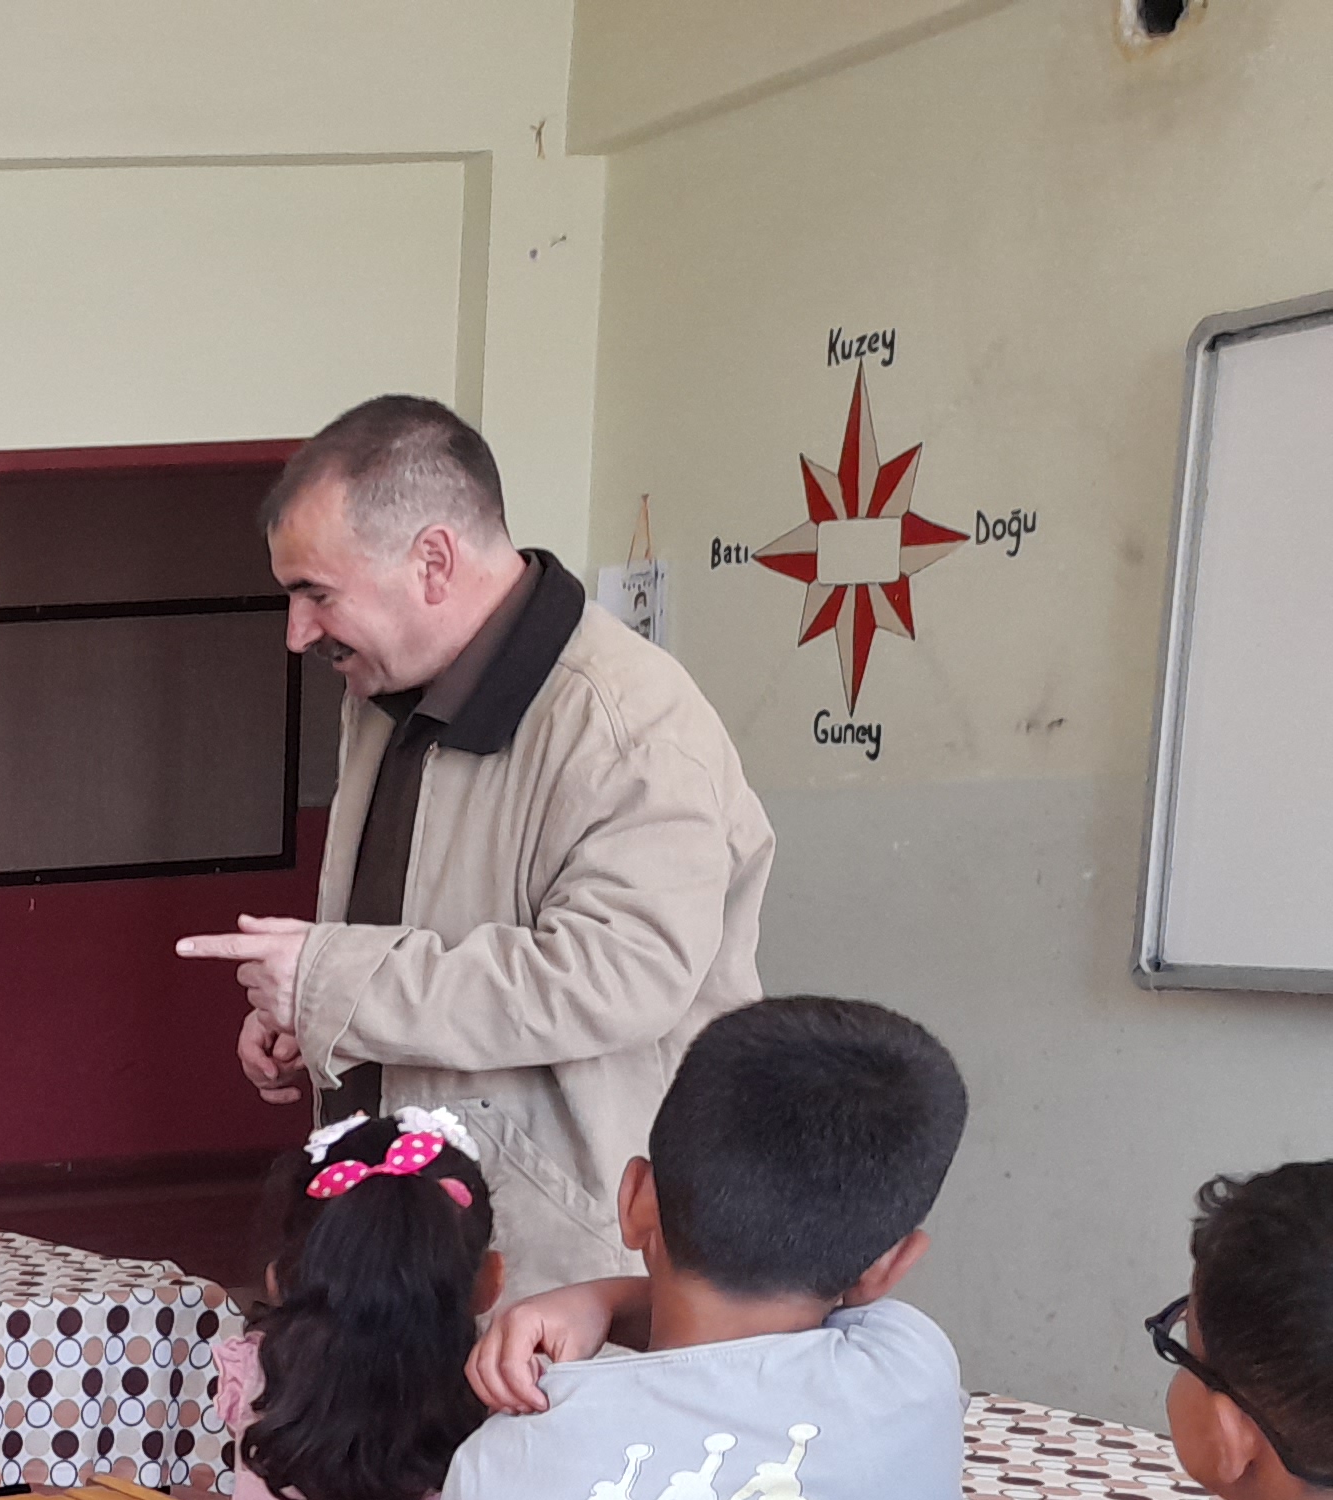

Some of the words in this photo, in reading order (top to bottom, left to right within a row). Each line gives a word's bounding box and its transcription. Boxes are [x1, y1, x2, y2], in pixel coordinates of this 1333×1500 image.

[827, 327, 896, 367] Kuzey
[975, 508, 1037, 557] Doğu
[711, 536, 749, 570] Batı
